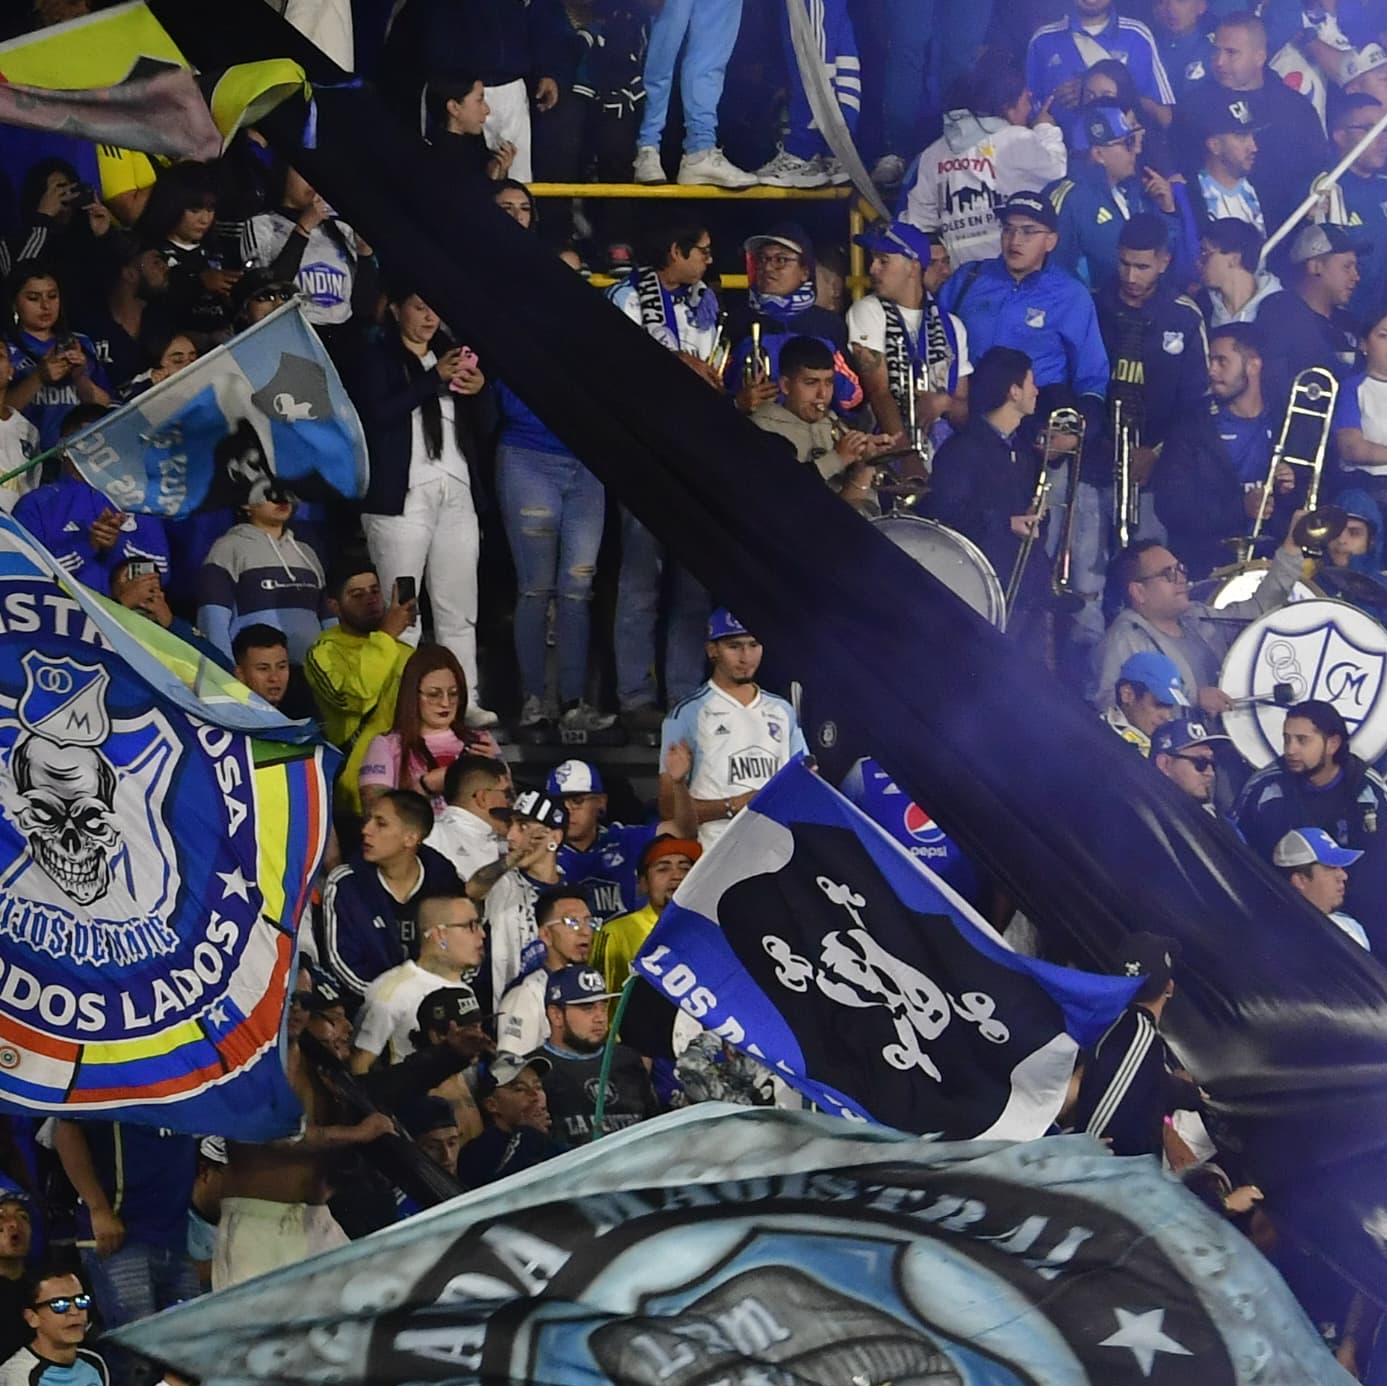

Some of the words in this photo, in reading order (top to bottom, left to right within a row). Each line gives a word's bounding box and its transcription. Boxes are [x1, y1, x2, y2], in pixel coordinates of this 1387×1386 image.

[0, 955, 105, 1033] DOS
[121, 908, 241, 1032] LADOS
[640, 945, 719, 1020] LOS
